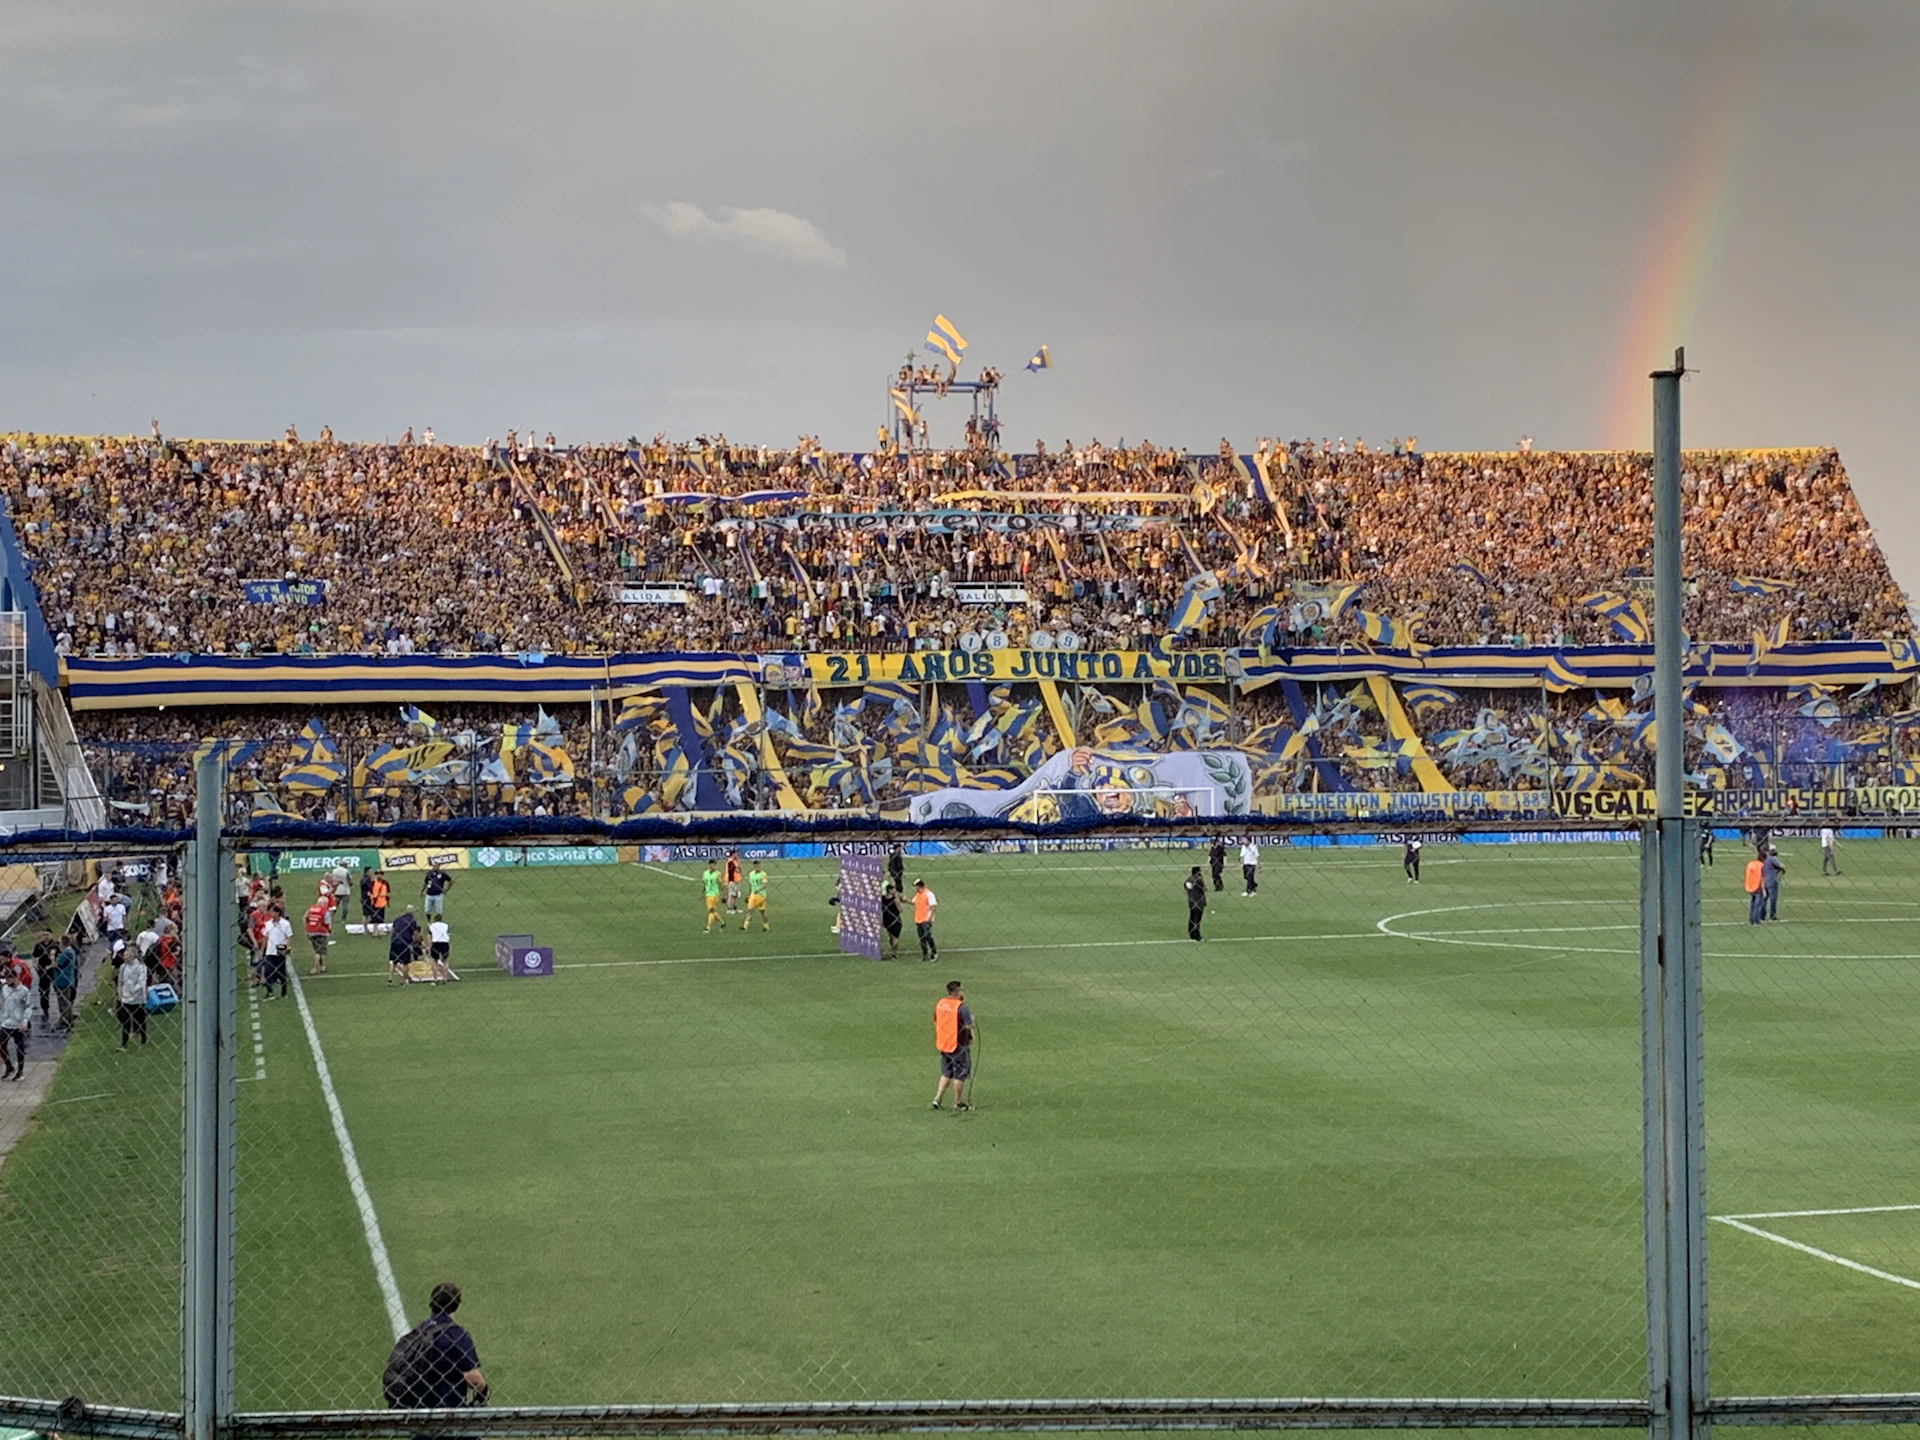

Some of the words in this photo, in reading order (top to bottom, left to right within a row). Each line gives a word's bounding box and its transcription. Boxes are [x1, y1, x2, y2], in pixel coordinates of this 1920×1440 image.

[622, 592, 663, 600] ALIDA
[958, 591, 1004, 600] SALIDA
[826, 654, 871, 682] 21
[1011, 650, 1124, 679] JUNTO
[1133, 653, 1159, 679] A
[1168, 653, 1223, 679] VOS
[1284, 793, 1380, 809] FISHERTON
[1389, 792, 1487, 808] INDUSTRIAL
[1555, 791, 1713, 817] V.G.GALEZ
[1714, 789, 1790, 811] ARROYO
[1800, 788, 1848, 810] SECO
[548, 848, 586, 861] Santa
[588, 848, 603, 860] Fe
